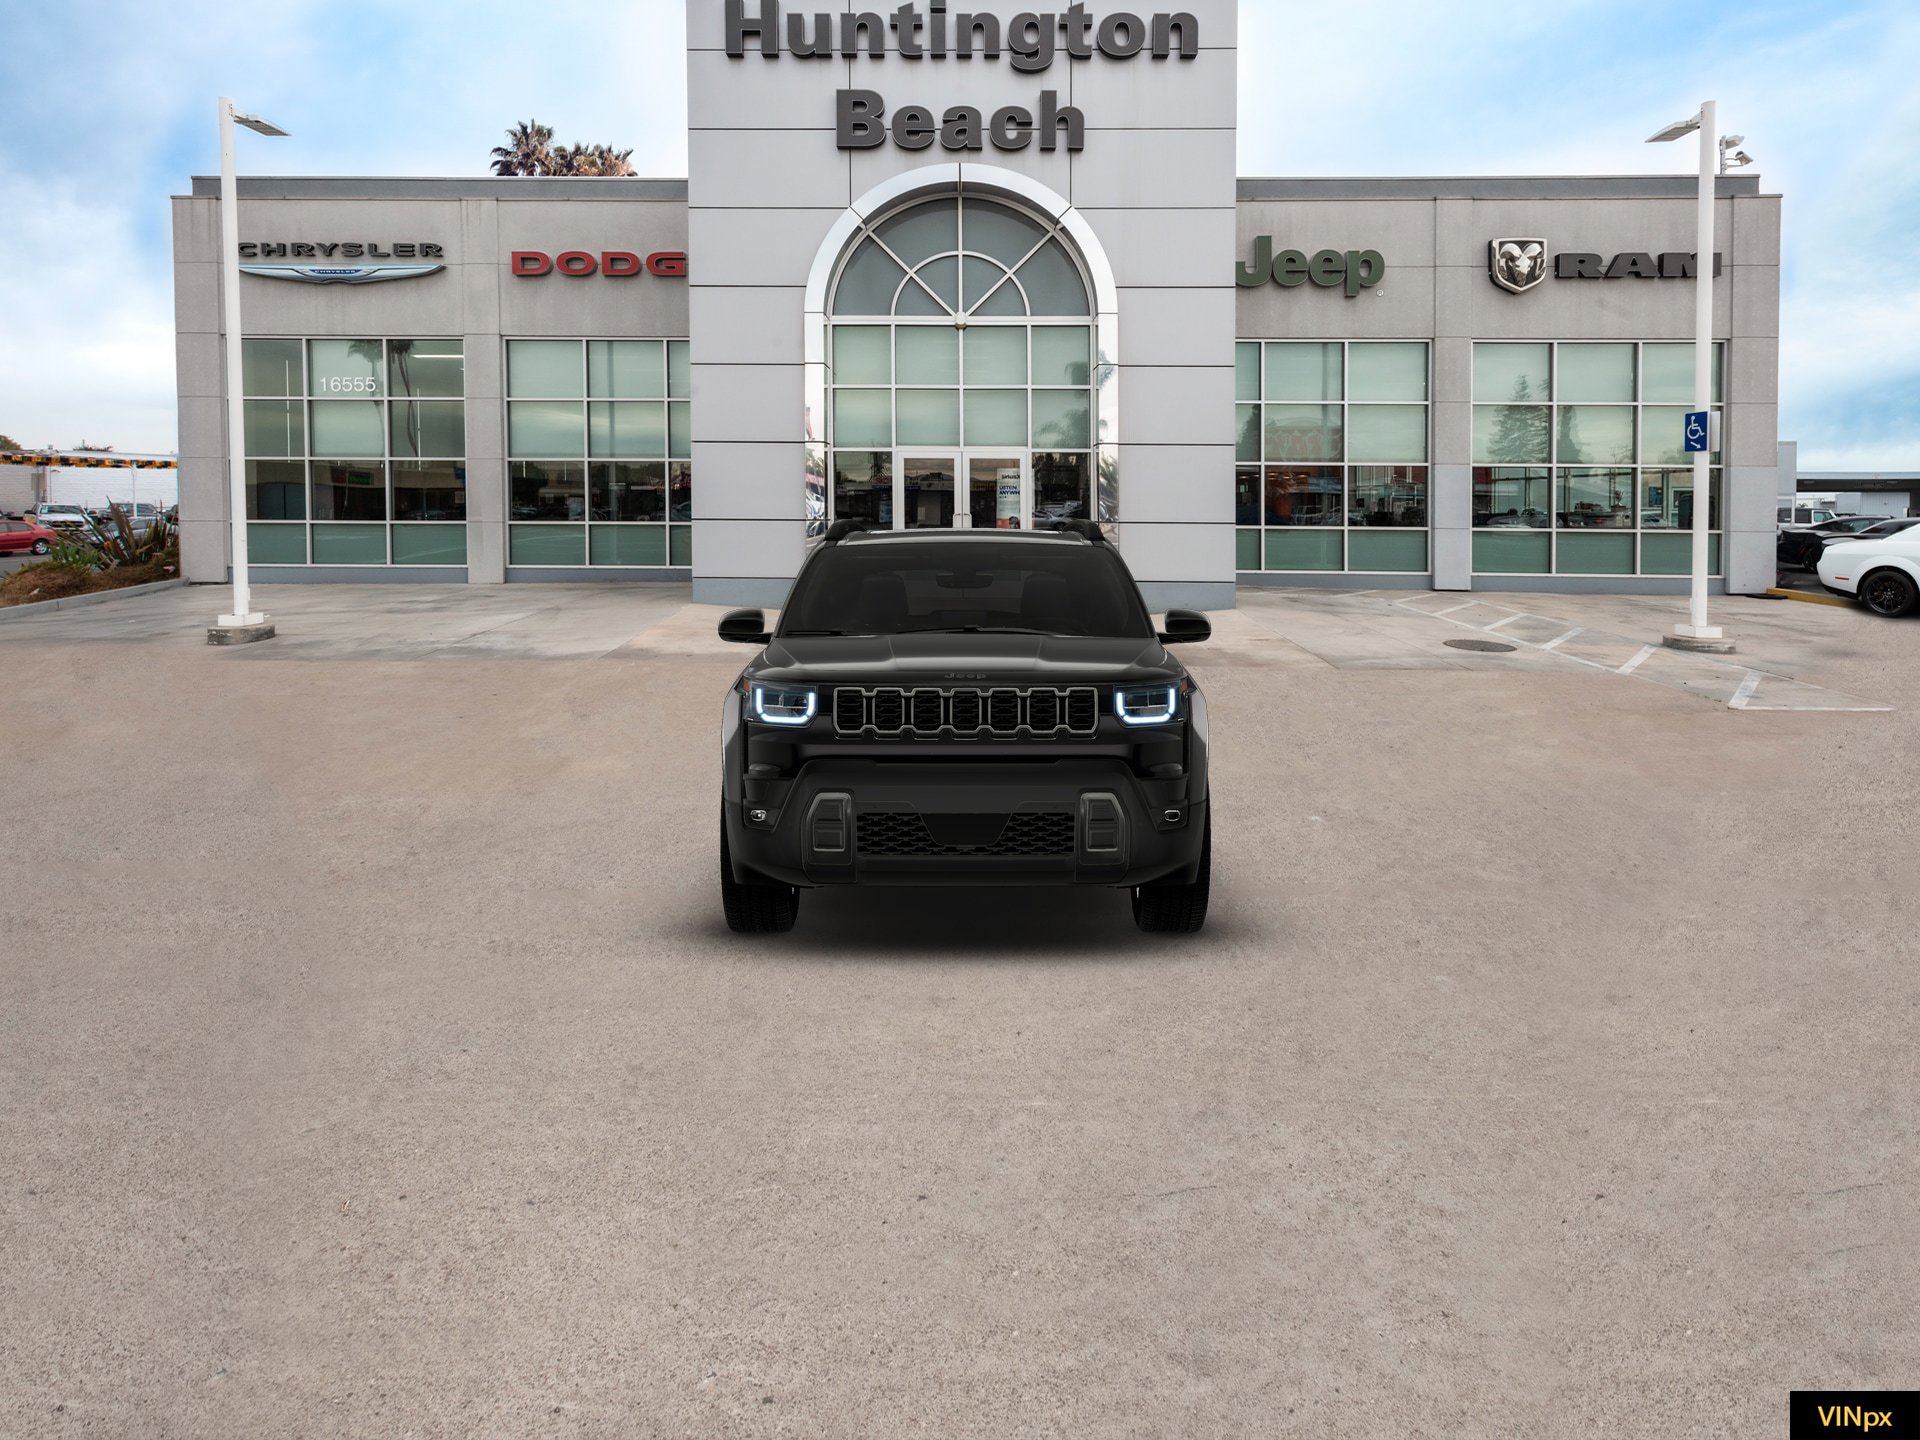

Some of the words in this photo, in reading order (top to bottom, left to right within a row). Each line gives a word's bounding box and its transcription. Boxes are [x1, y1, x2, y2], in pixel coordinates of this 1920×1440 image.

[724, 0, 1199, 73] Huntington
[836, 89, 1085, 152] Beach
[238, 242, 444, 258] CHRYSLER
[1235, 235, 1385, 297] Jeep
[1554, 252, 1722, 279] RAM
[319, 376, 376, 392] 16555
